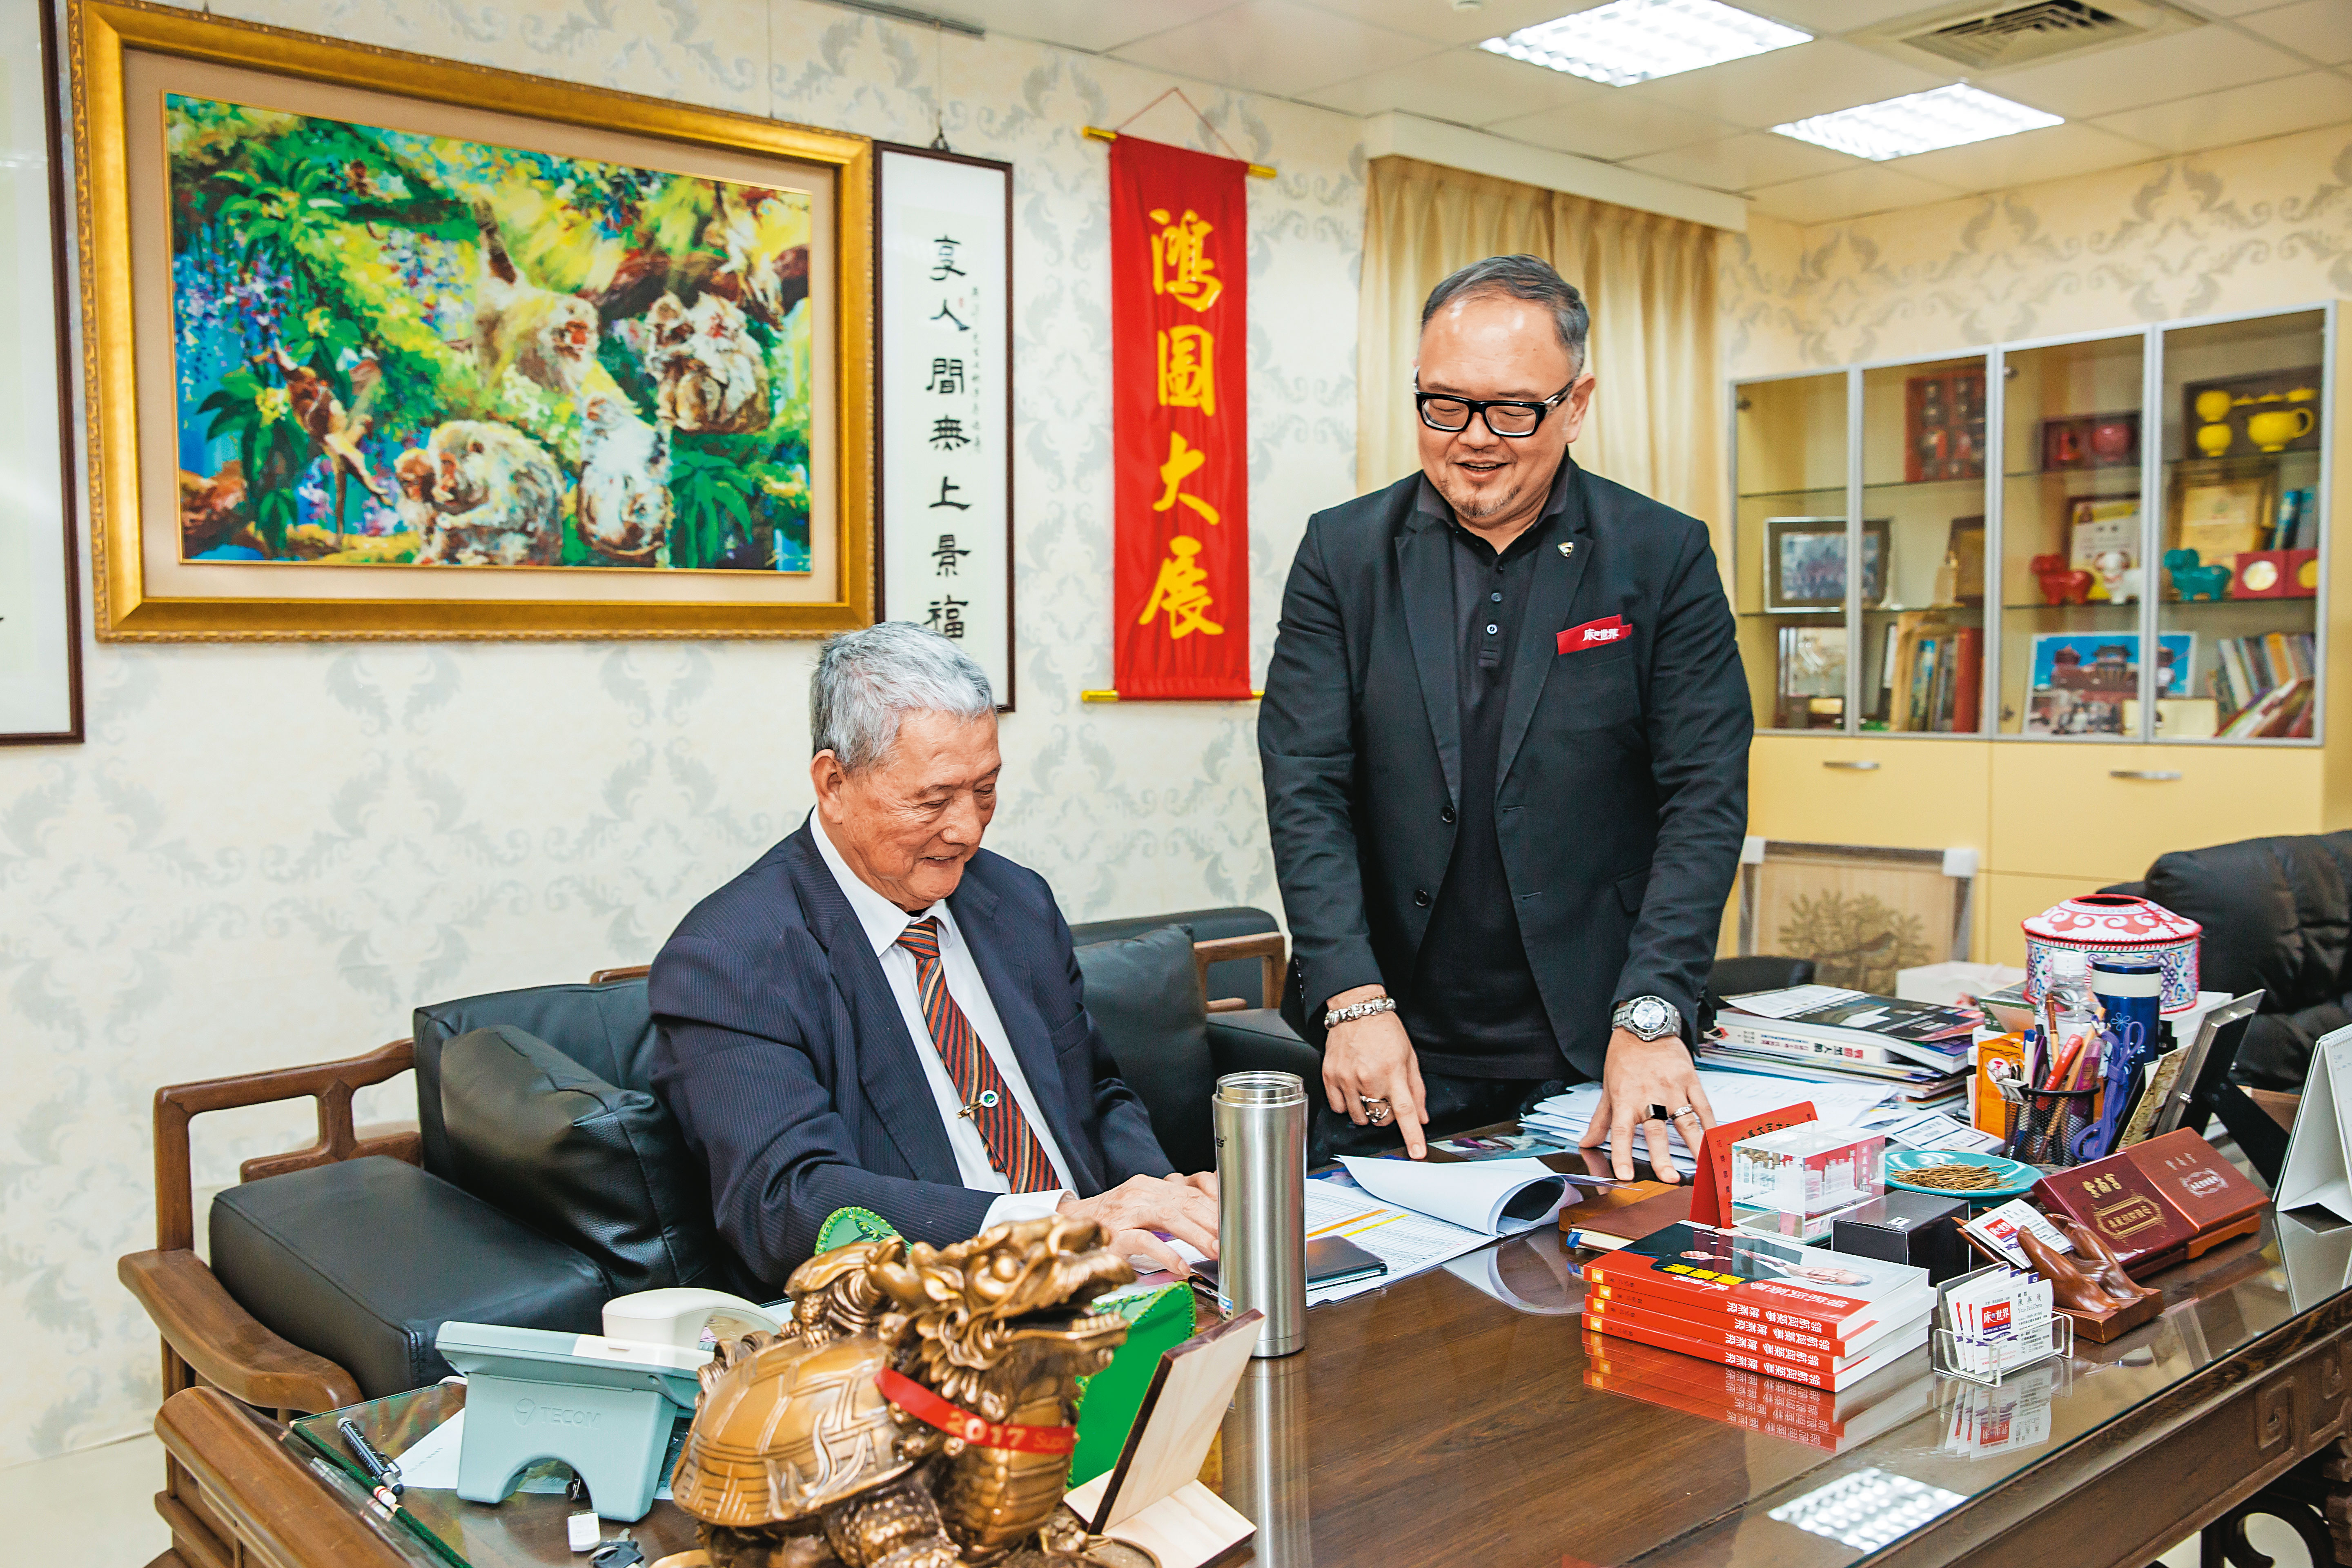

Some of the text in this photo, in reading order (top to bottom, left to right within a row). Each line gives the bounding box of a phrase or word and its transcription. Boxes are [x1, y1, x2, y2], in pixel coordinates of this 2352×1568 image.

[1139, 209, 1223, 640] 鴻圖大展
[1726, 1301, 1760, 1319] 陳燕飛
[1983, 1307, 2010, 1323] 床的世界
[1734, 1318, 1767, 1336] 陳燕飛
[1765, 1311, 1822, 1333] 領航與築夢
[1725, 1333, 1757, 1351] 陳燕飛
[1773, 1328, 1830, 1351] 領航與築夢
[1725, 1352, 1758, 1370] 陳燕飛
[1762, 1343, 1819, 1367] 領航與築夢
[1763, 1362, 1820, 1385] 領航與築夢
[541, 1406, 601, 1429] TECOM
[946, 1411, 1027, 1448] 2017
